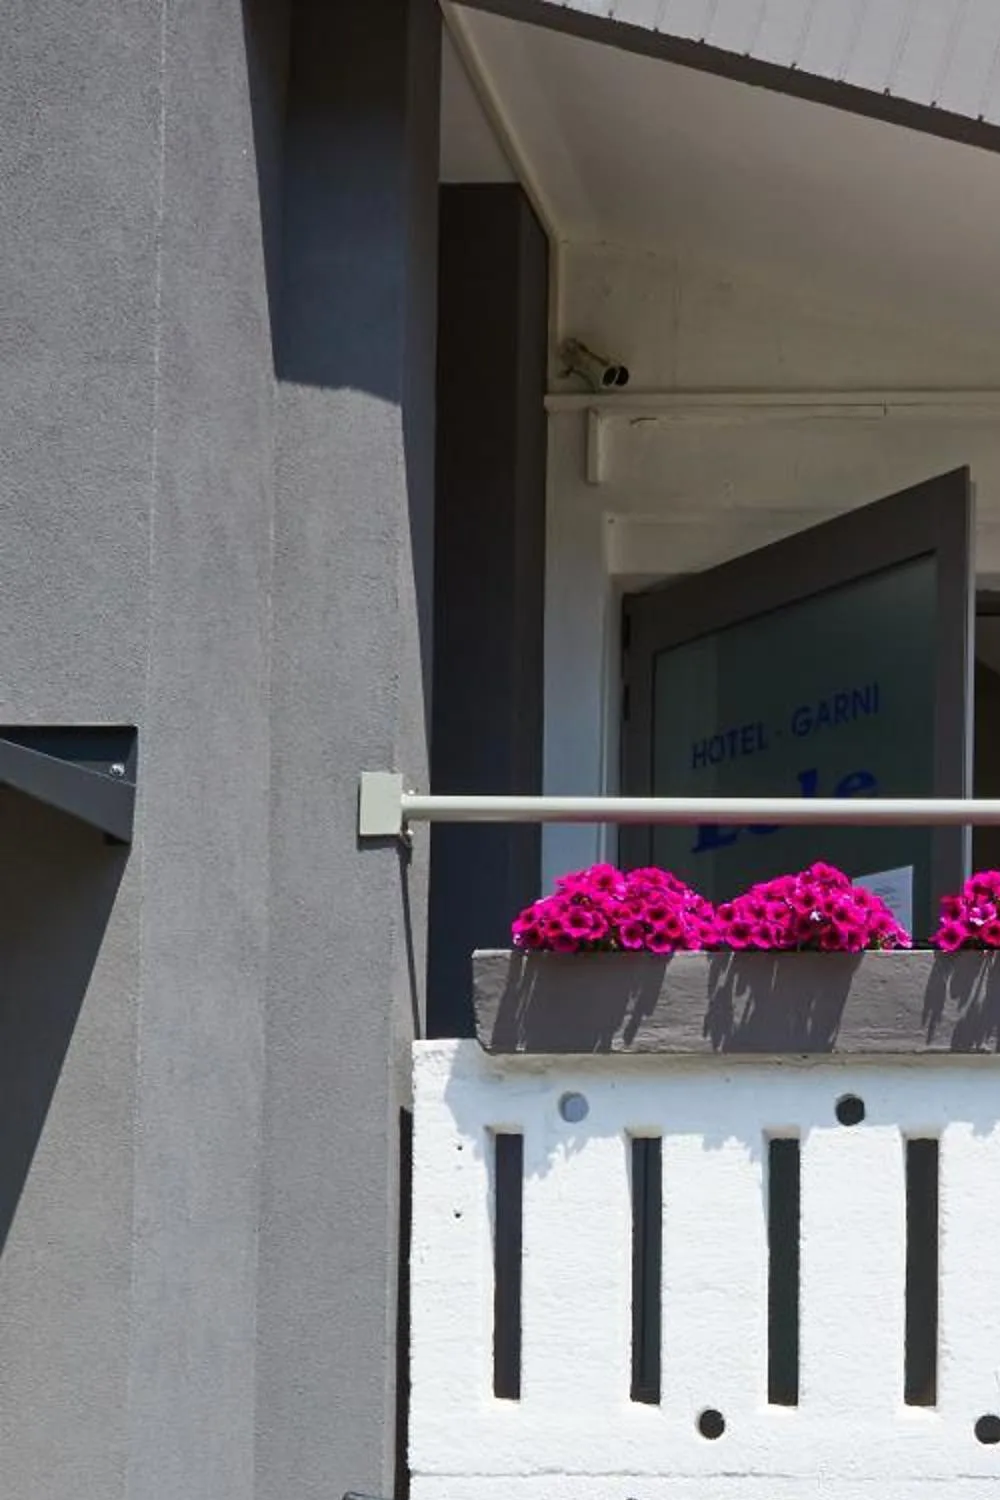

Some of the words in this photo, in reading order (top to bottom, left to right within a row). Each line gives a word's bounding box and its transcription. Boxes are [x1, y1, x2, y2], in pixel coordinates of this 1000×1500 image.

[691, 721, 768, 769] HOTEL
[791, 681, 879, 737] GARNI
[690, 768, 877, 853] Lle
